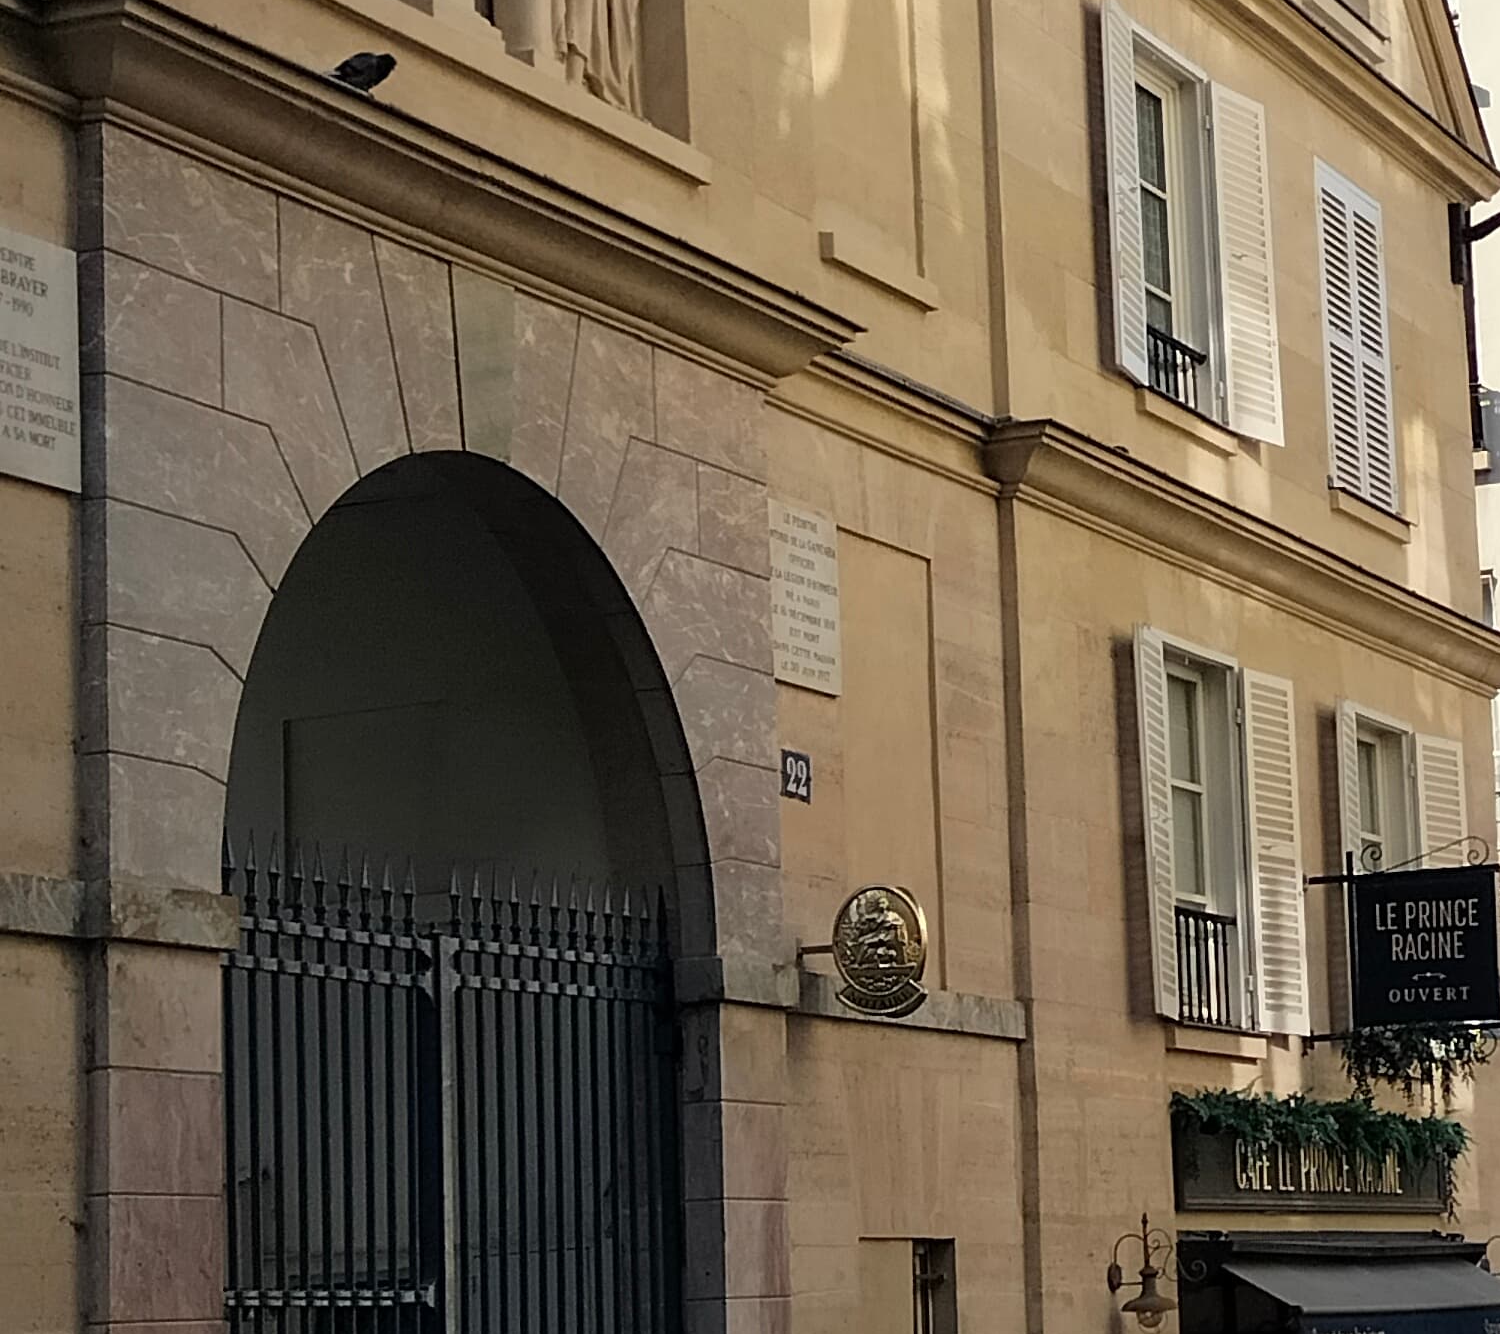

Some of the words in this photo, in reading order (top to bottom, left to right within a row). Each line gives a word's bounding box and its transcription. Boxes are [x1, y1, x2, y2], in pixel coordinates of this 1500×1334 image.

[786, 756, 808, 797] 22
[1375, 902, 1398, 931] LE
[1404, 898, 1479, 930] PRINCE
[1391, 930, 1465, 962] RACINE
[1388, 986, 1470, 1003] OUVERT
